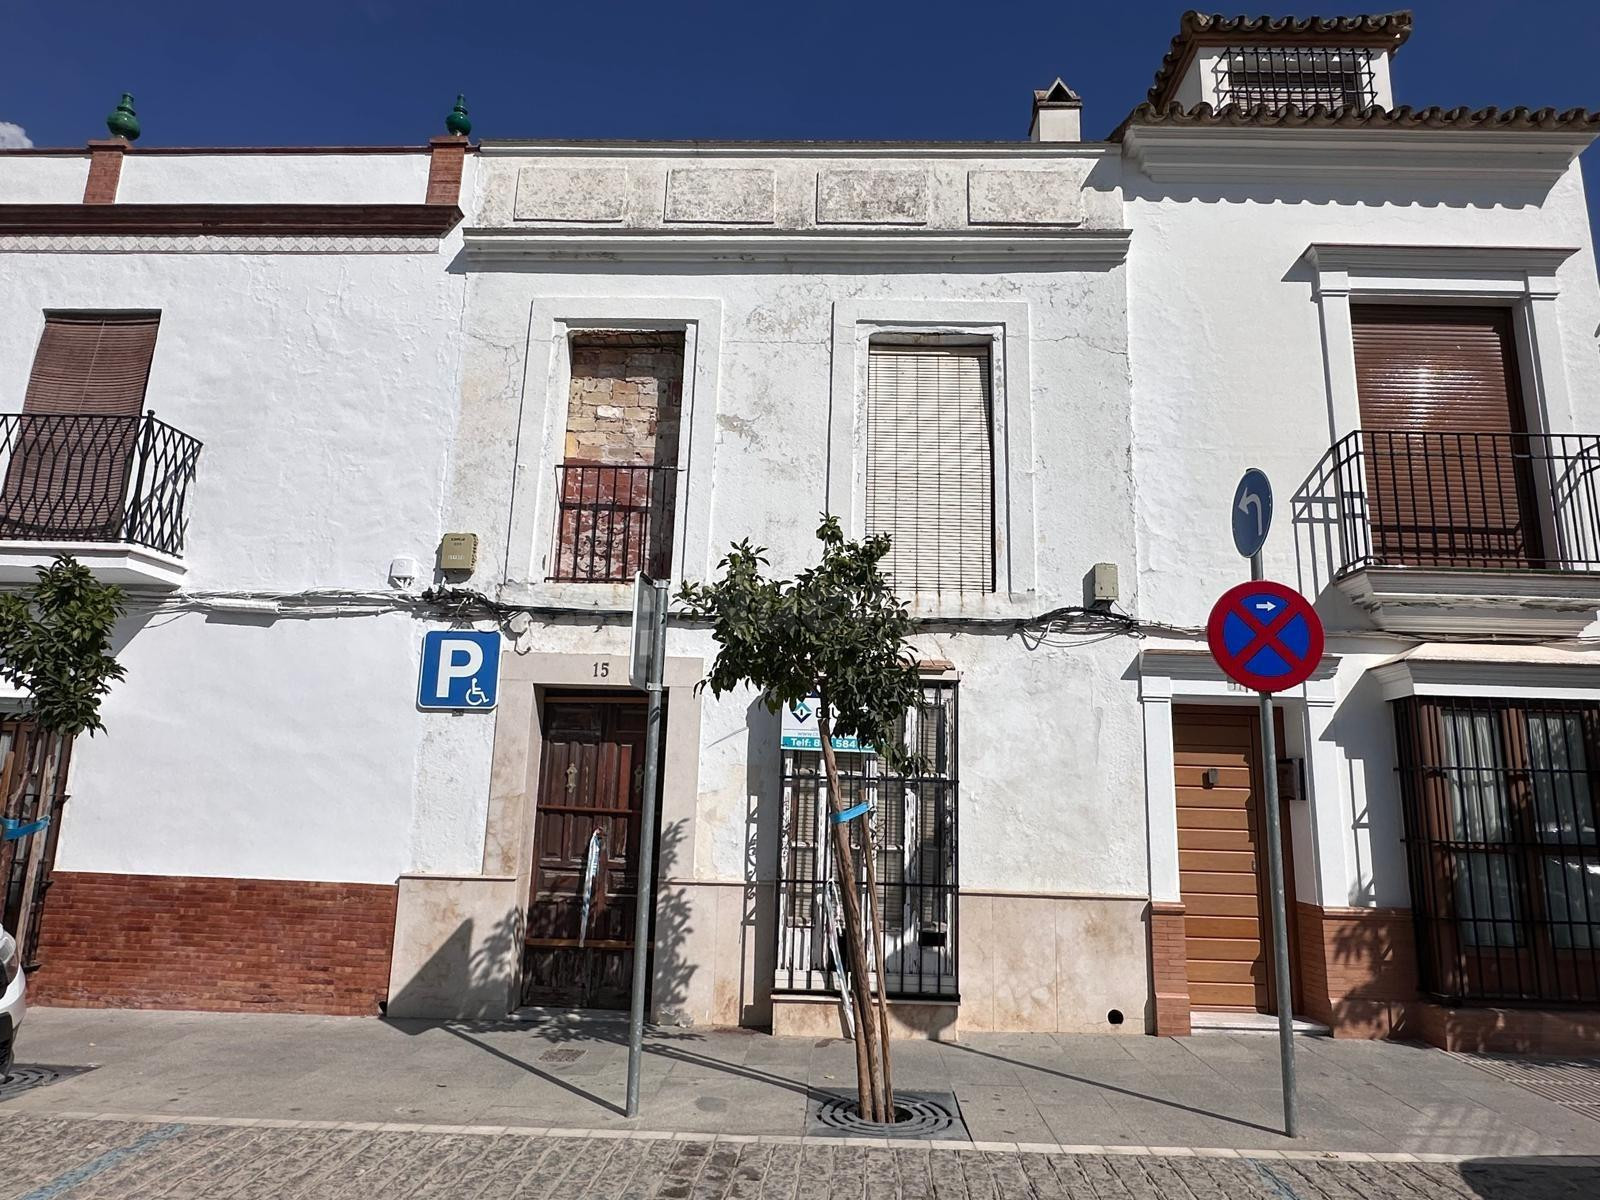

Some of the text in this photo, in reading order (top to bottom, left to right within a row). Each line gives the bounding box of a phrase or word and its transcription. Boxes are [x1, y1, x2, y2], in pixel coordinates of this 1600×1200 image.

[436, 639, 484, 698] P
[593, 662, 610, 678] 15
[791, 738, 812, 747] Telf:
[836, 739, 856, 748] 584
